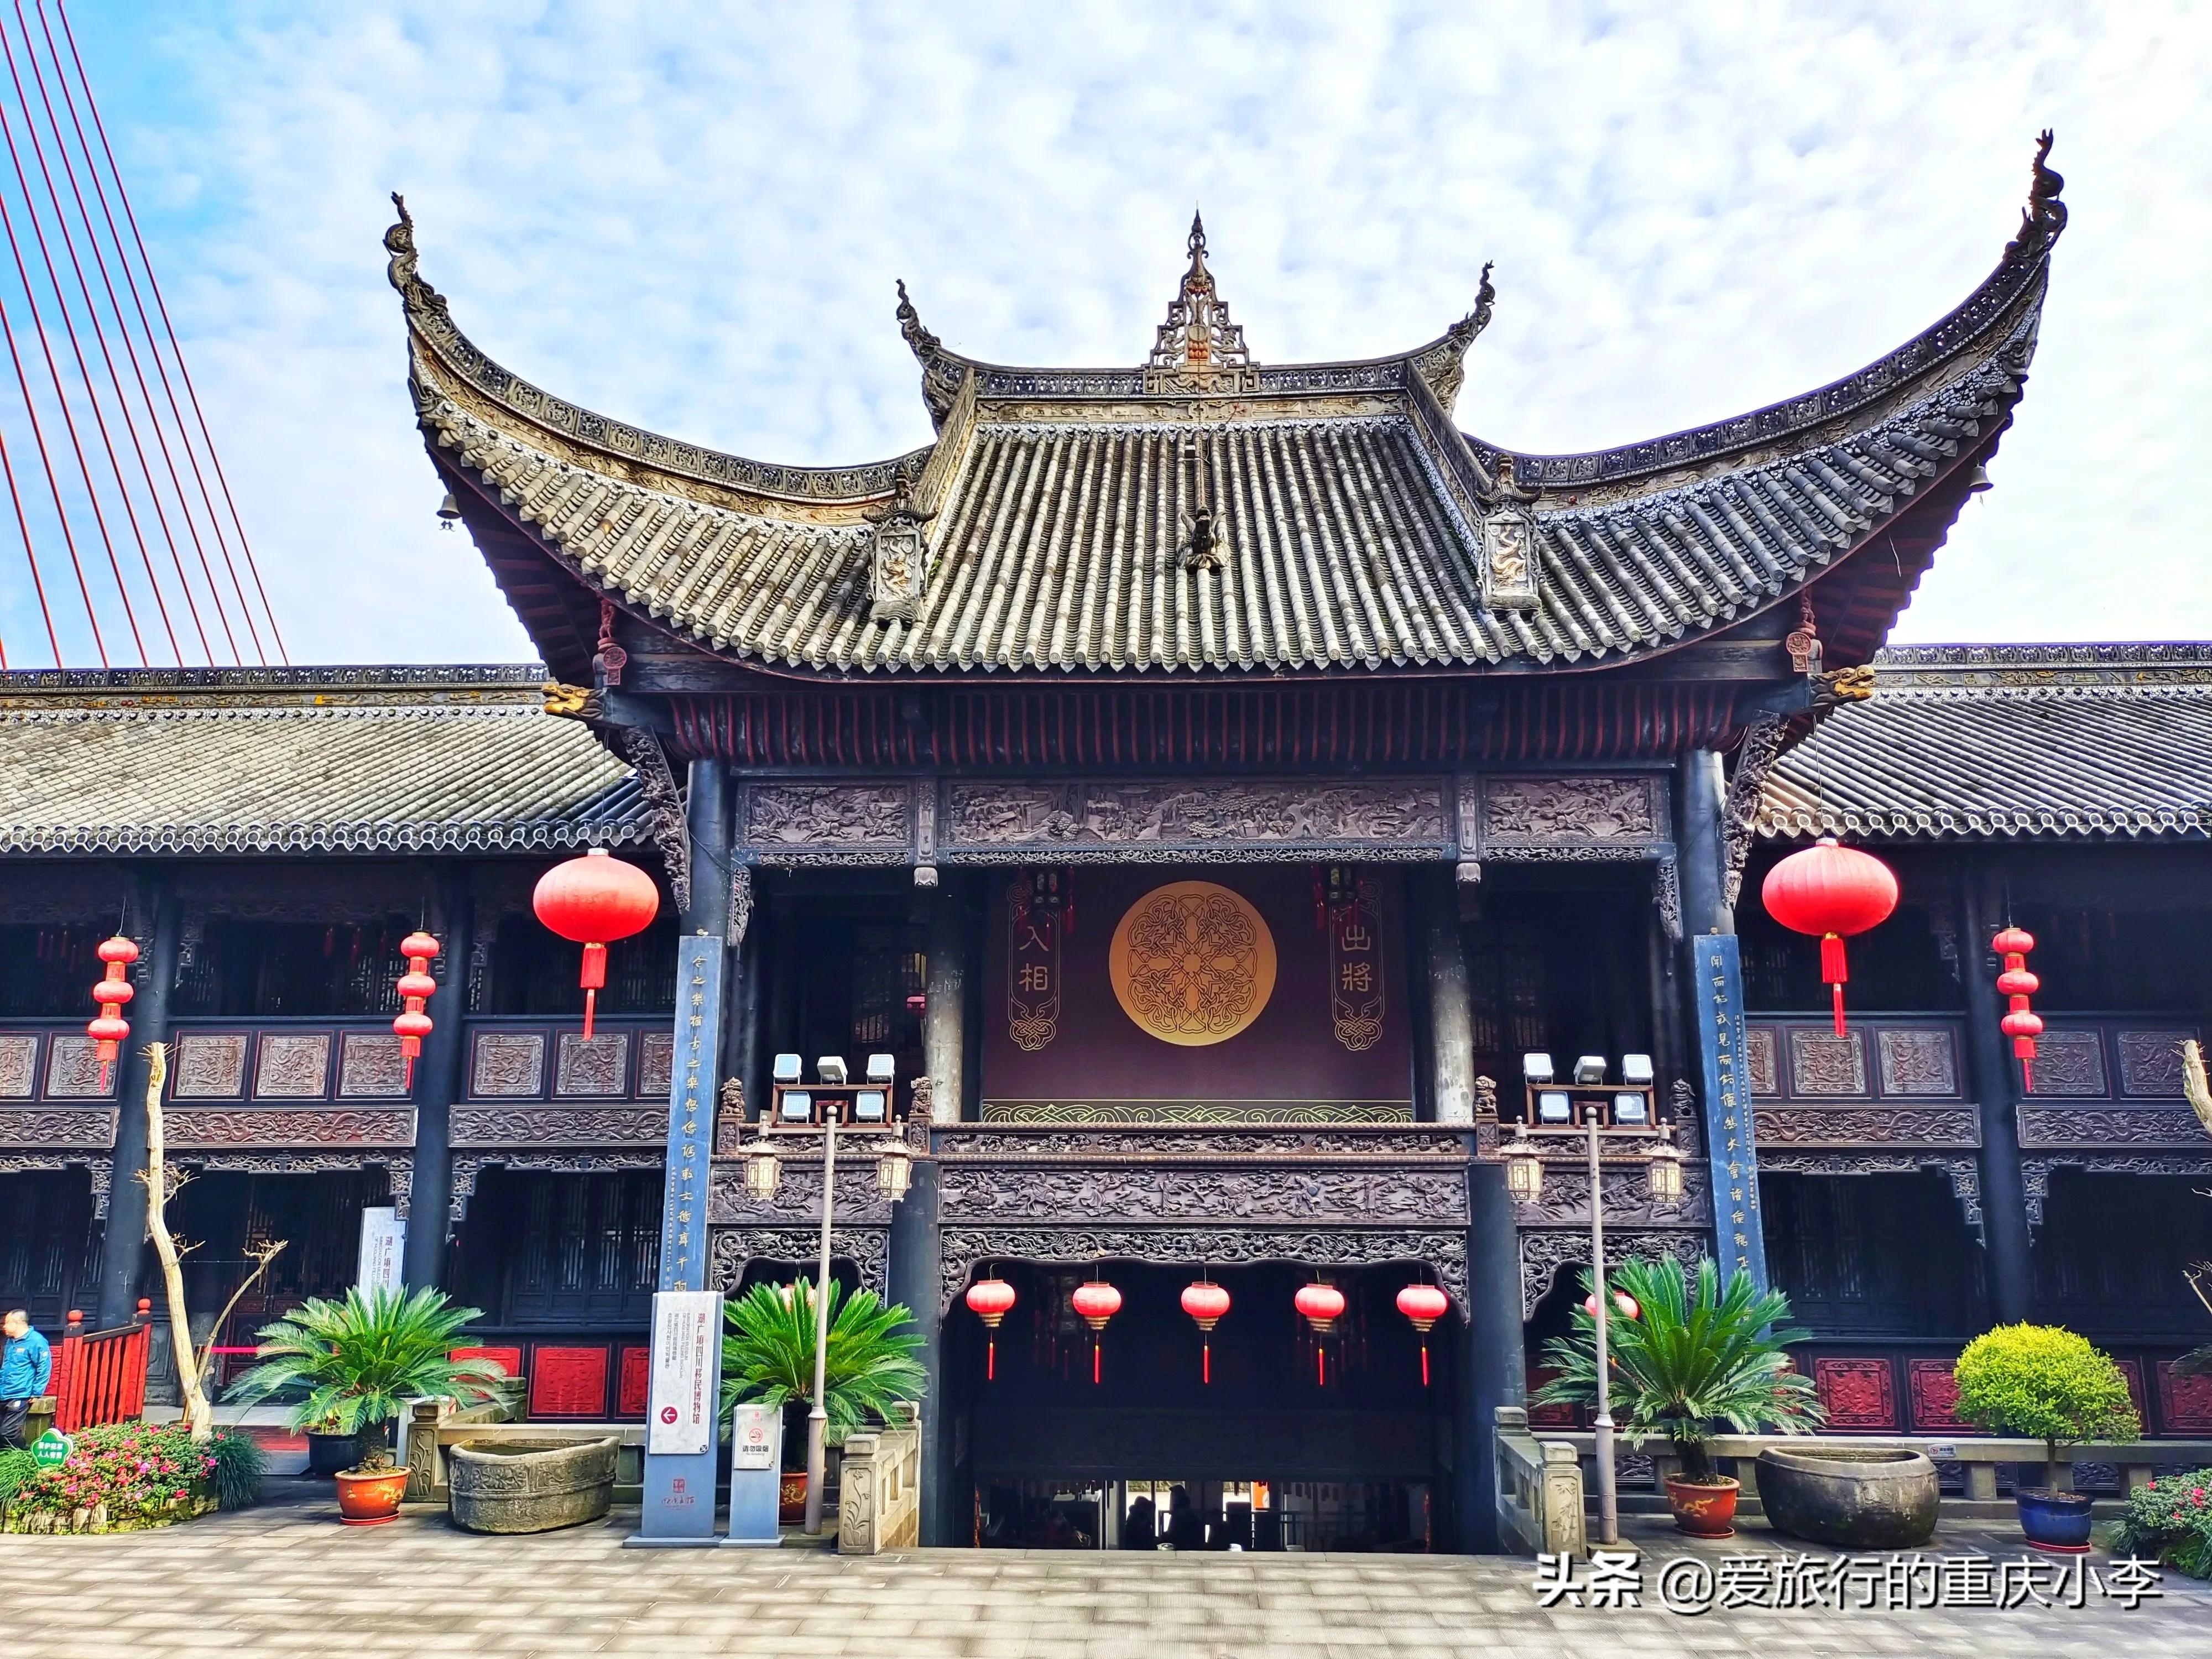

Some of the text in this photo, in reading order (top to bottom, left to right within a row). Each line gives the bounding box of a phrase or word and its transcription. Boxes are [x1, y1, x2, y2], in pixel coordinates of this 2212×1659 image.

[1019, 926, 1049, 992] 入相
[1342, 925, 1373, 992] 出將
[692, 1313, 705, 1425] 湖广填四川移民博物馆
